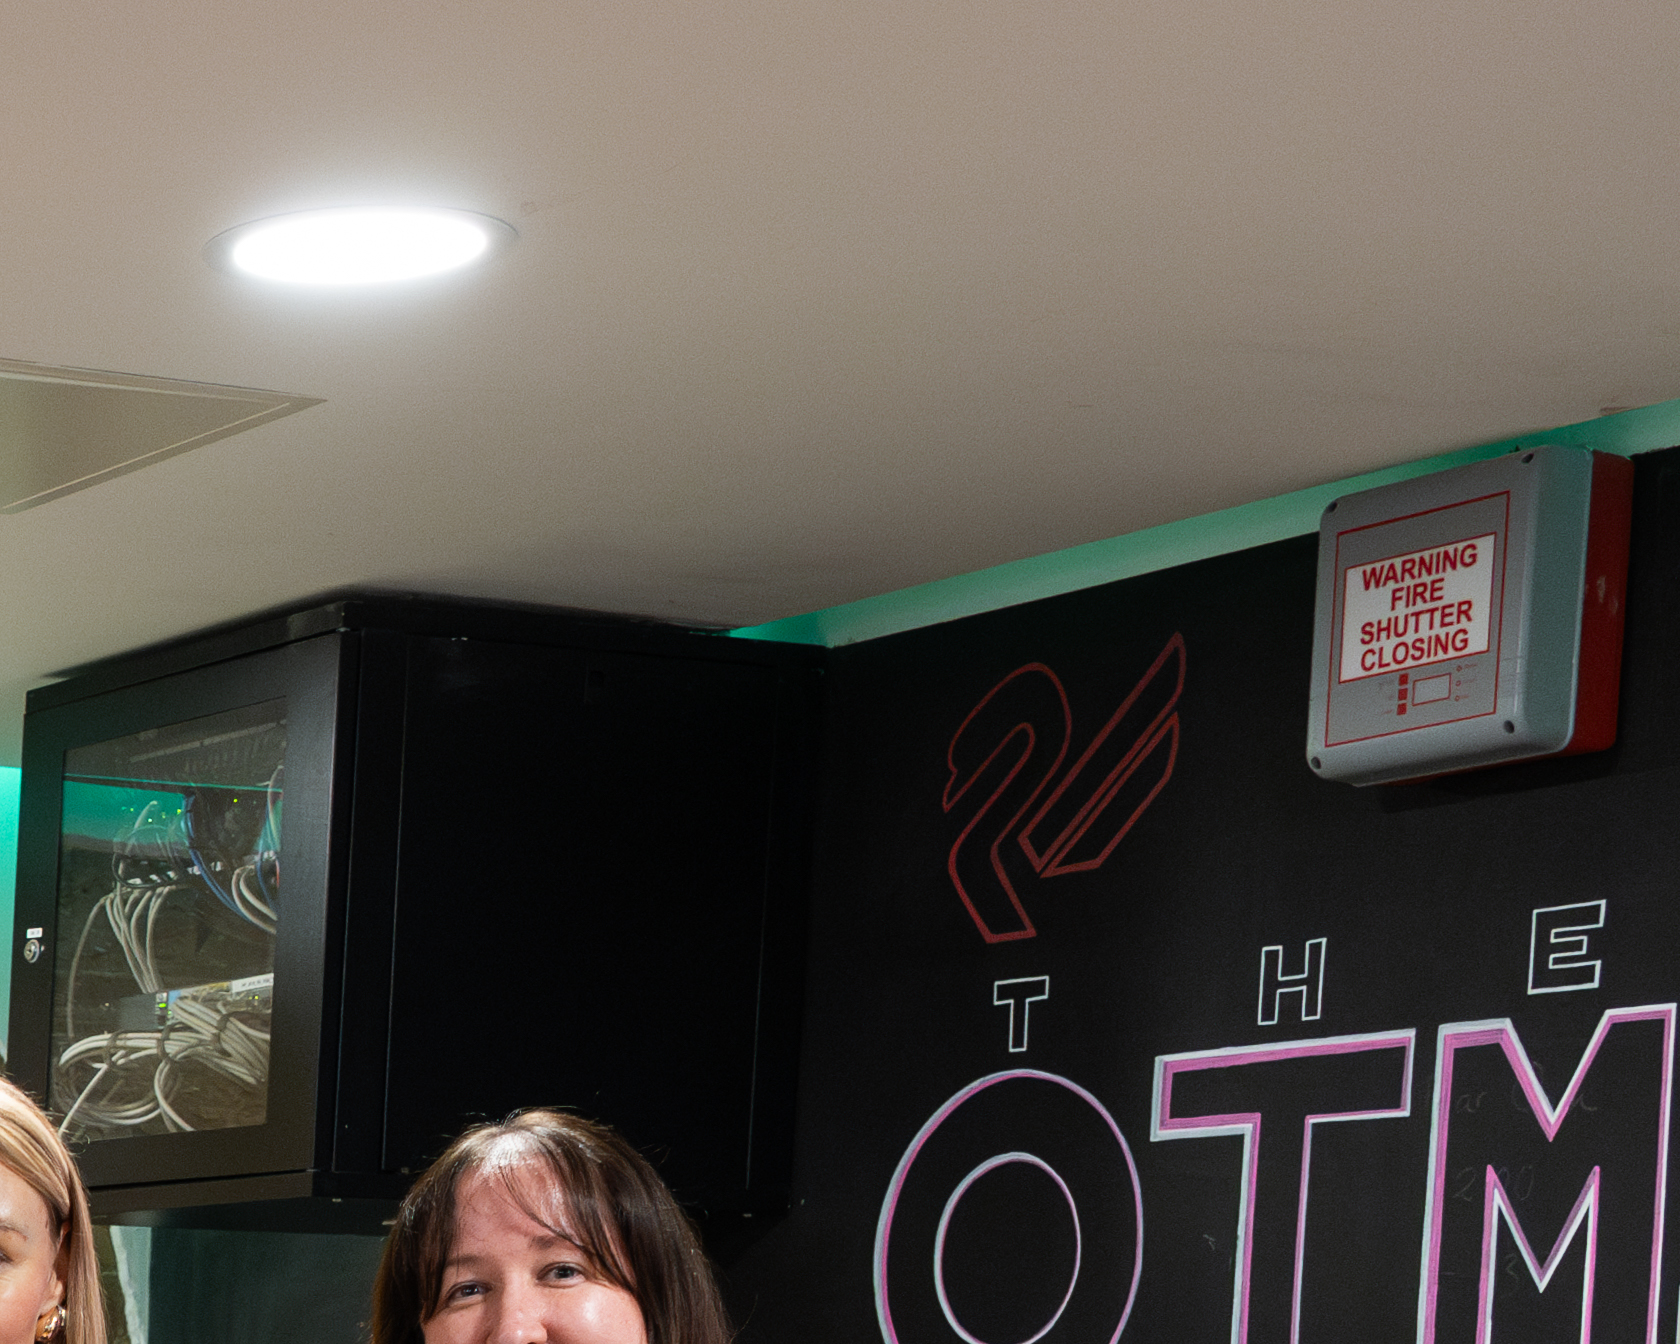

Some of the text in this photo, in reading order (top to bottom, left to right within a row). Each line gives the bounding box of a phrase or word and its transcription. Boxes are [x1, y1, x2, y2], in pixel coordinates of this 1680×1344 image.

[1362, 543, 1477, 591] WARNING
[1391, 578, 1445, 611] FIRE
[1360, 600, 1473, 645] SHUTTER
[1360, 628, 1469, 672] CLOSING
